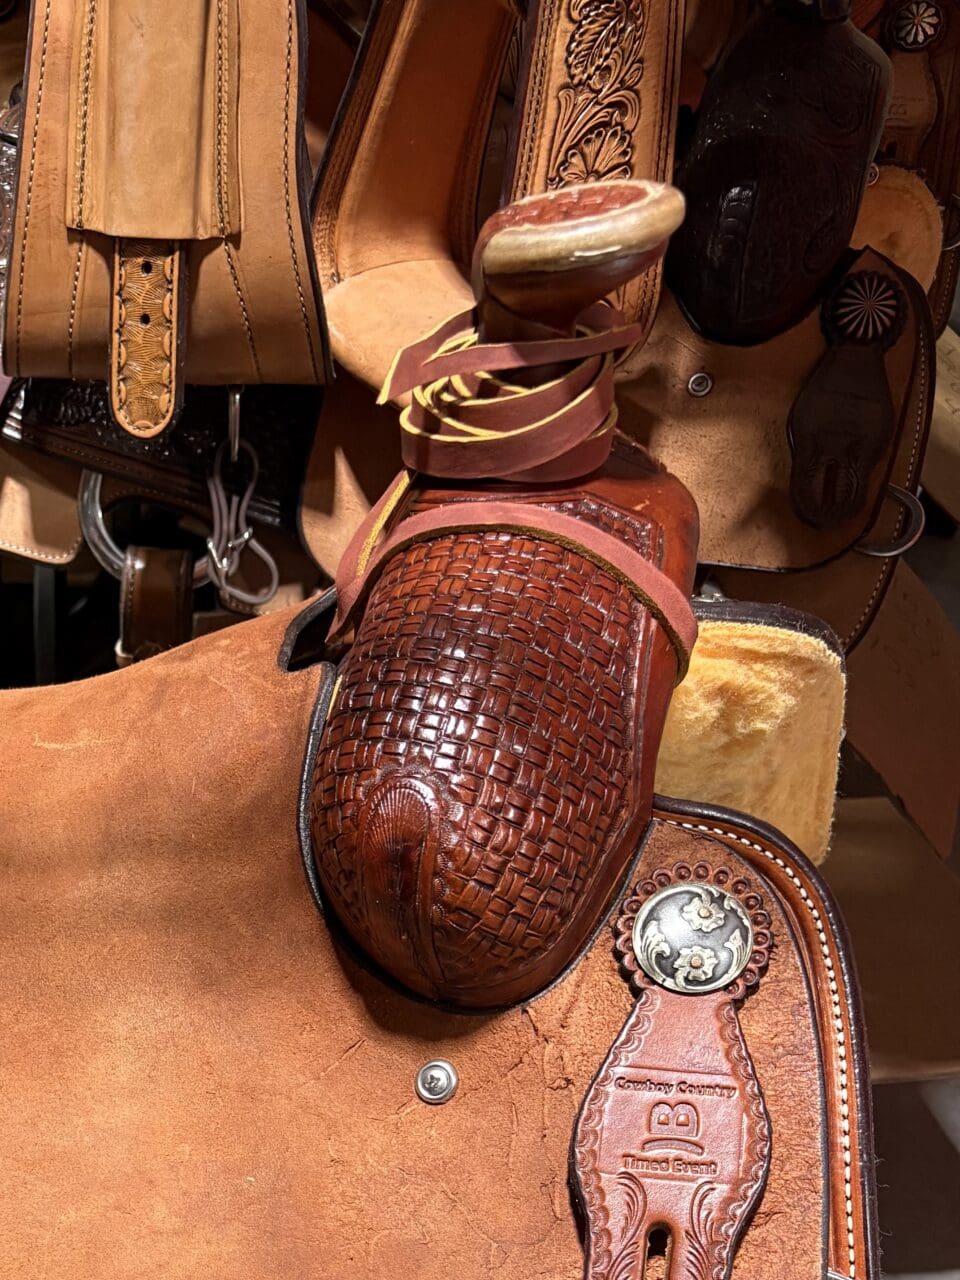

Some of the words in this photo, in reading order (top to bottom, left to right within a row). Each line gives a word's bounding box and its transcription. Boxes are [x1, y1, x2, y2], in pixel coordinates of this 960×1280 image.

[614, 1076, 674, 1094] Cowboy
[675, 1080, 737, 1099] Country
[622, 1152, 670, 1173] Timed
[672, 1158, 718, 1175] Event
